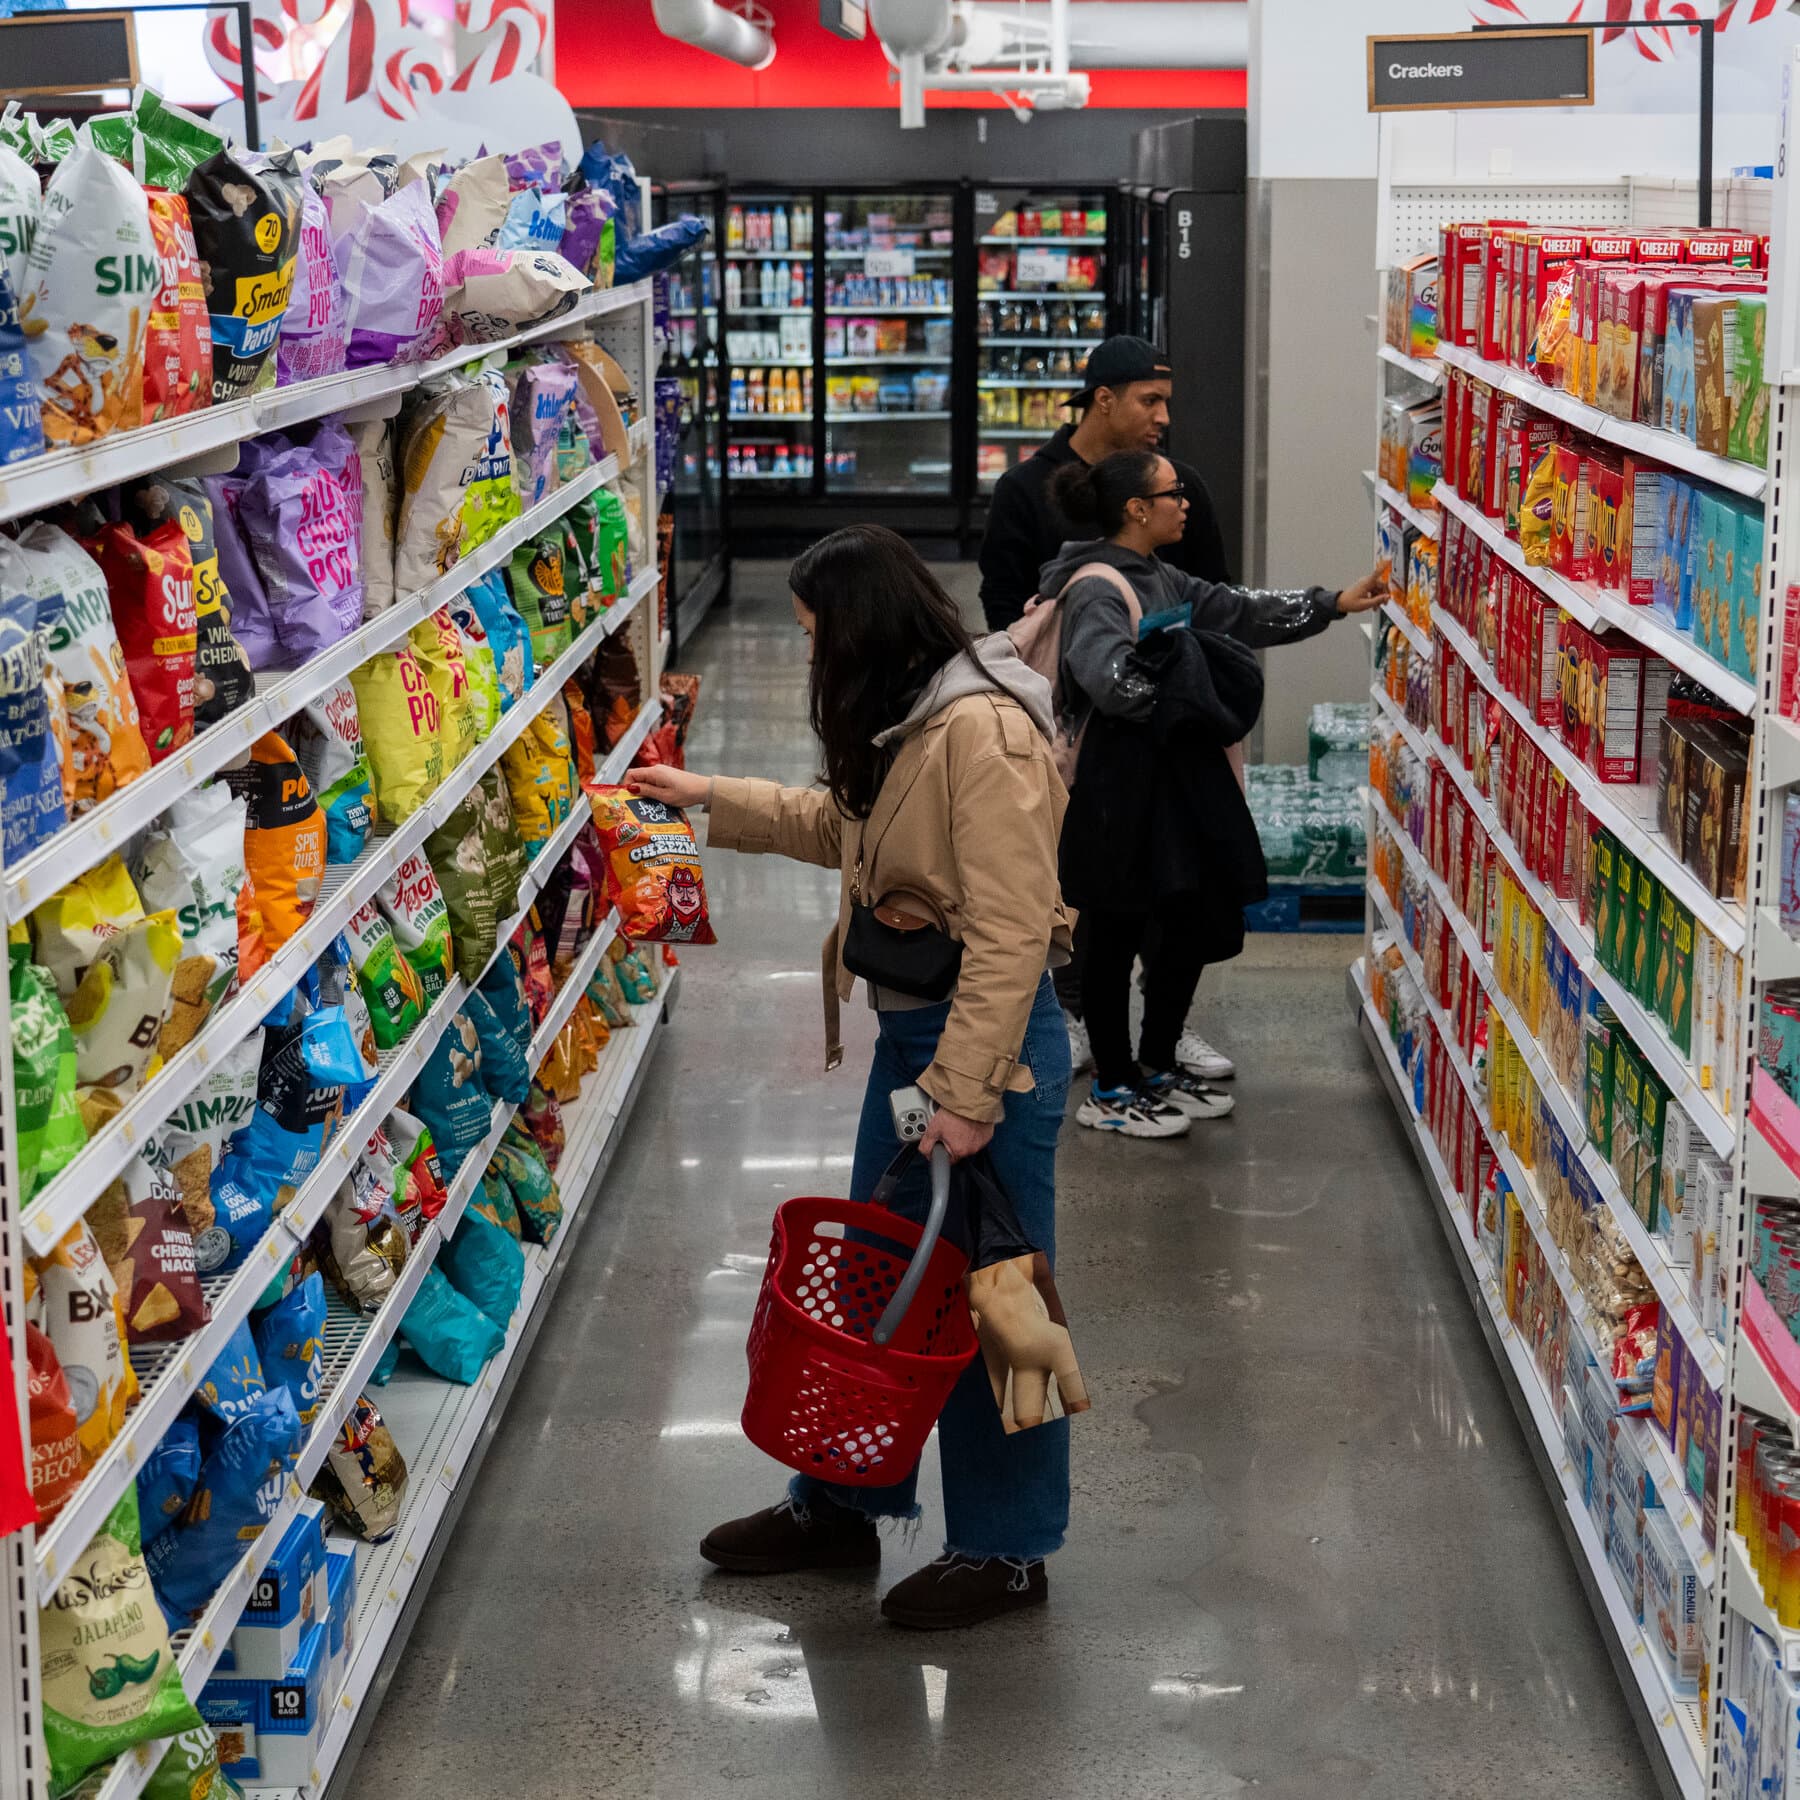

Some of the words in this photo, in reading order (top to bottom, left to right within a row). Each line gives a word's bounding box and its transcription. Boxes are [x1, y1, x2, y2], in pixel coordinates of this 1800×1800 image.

[1388, 62, 1464, 79] Crackers
[266, 219, 278, 238] 70
[1178, 210, 1193, 260] B15
[242, 319, 279, 353] Party
[1529, 431, 1559, 442] GROOVES
[182, 511, 196, 529] 70
[650, 834, 692, 842] CRUNCHY
[424, 972, 440, 985] SEA
[425, 979, 443, 993] SALT
[251, 1600, 273, 1608] BAGS
[1686, 1574, 1696, 1624] PREMIUM
[273, 1690, 300, 1709] 10
[278, 1707, 299, 1716] BAGS
